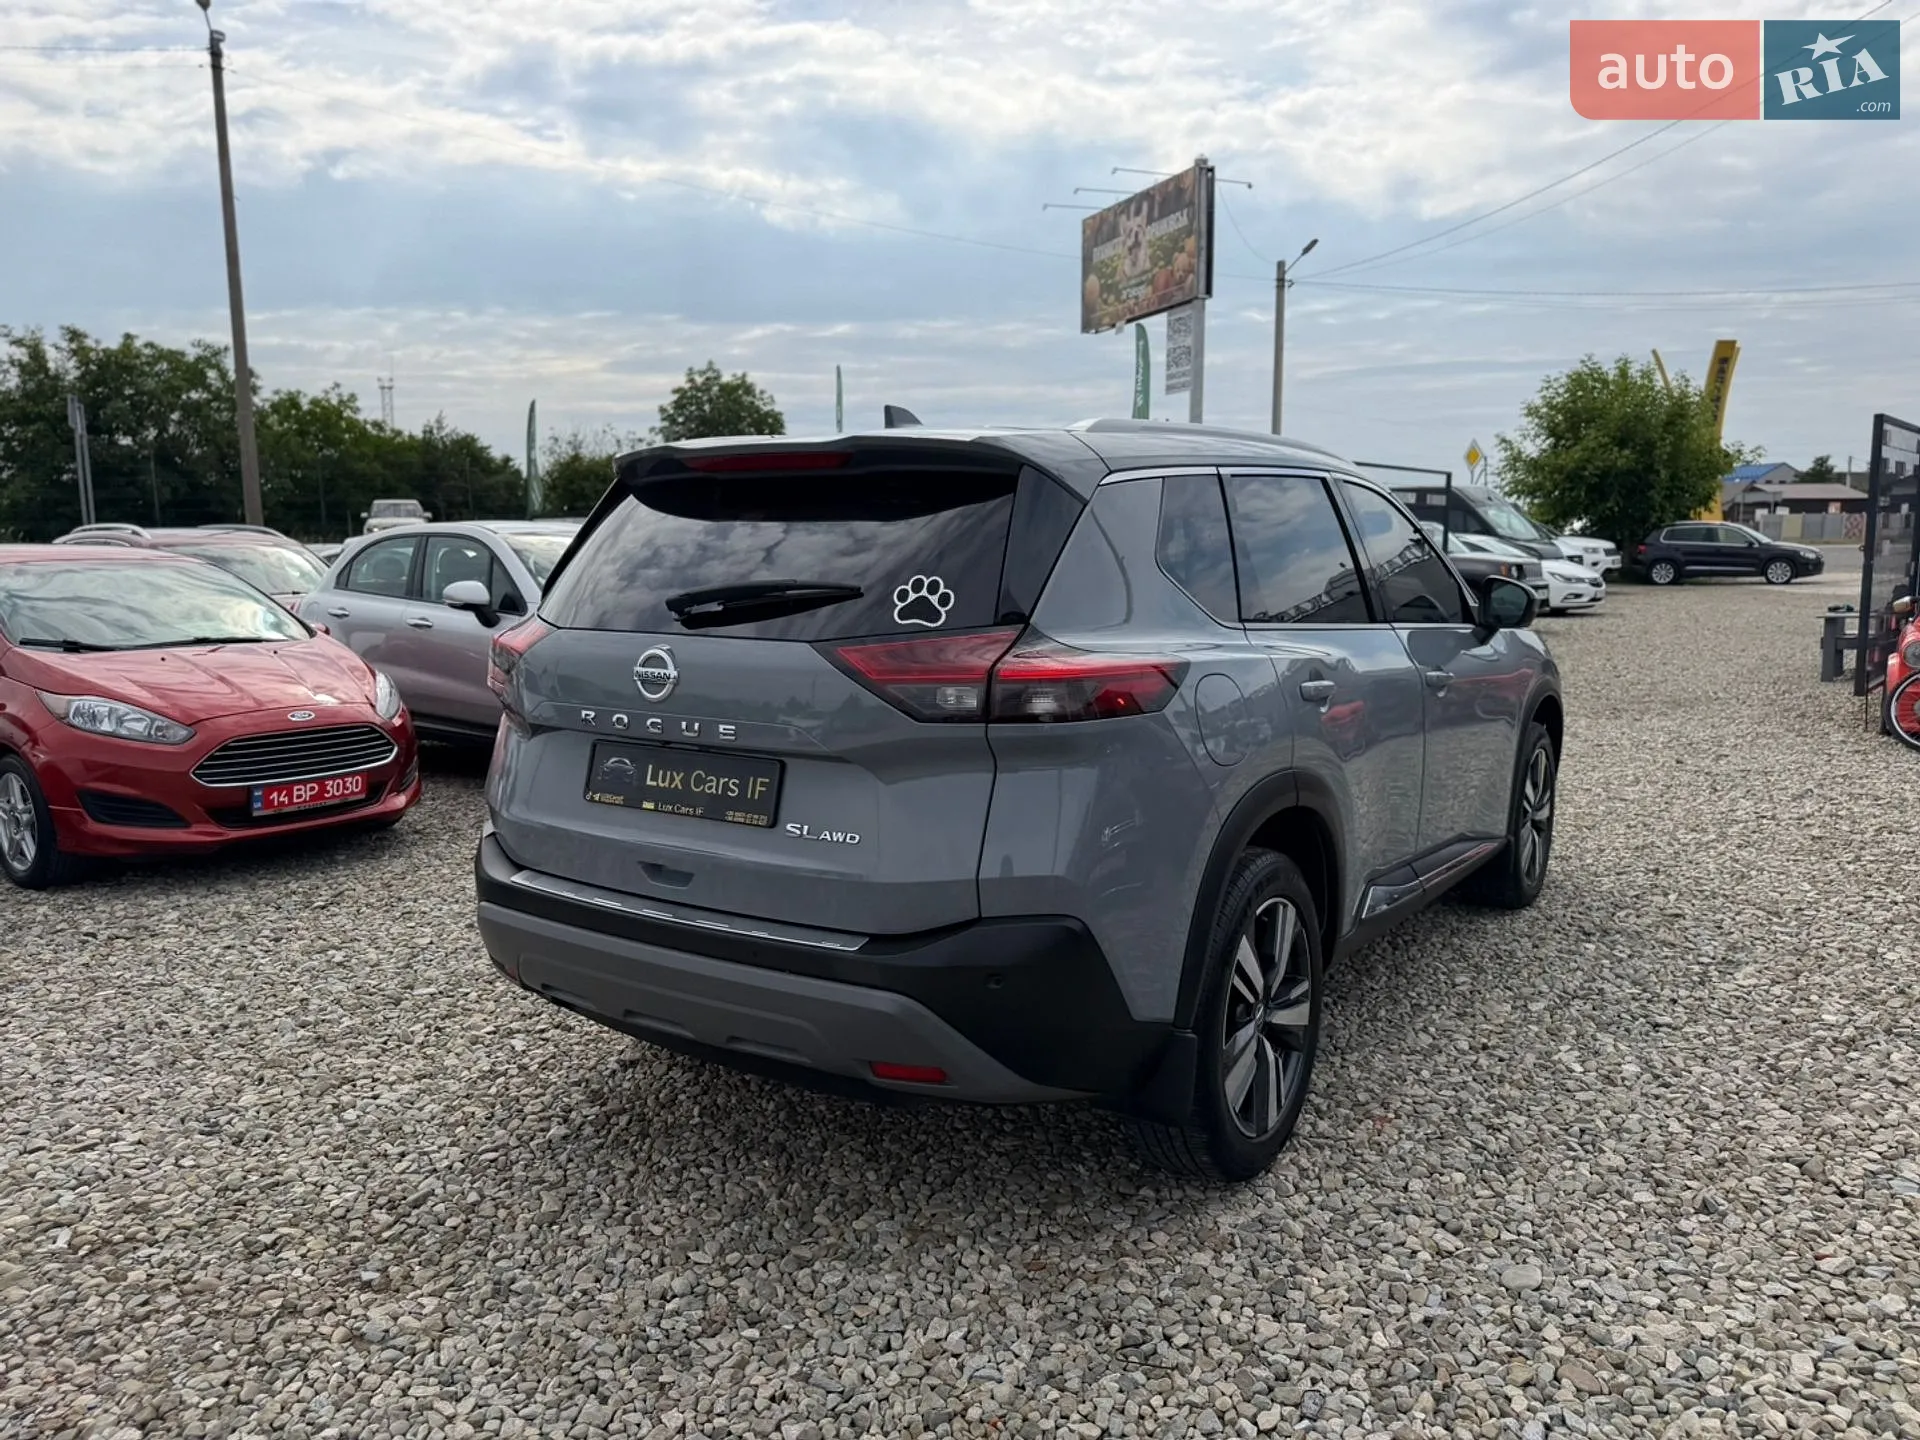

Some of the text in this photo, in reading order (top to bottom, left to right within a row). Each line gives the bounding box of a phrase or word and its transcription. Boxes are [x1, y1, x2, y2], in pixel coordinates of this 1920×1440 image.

[634, 669, 671, 681] NISSAN
[580, 709, 737, 741] ROGUE
[269, 789, 288, 807] 14
[293, 782, 319, 803] BP
[324, 775, 362, 798] 3030
[645, 763, 770, 800] Lux Cars IF
[658, 802, 673, 812] Lux
[674, 804, 694, 815] Cars
[785, 823, 861, 845] SL AWD
